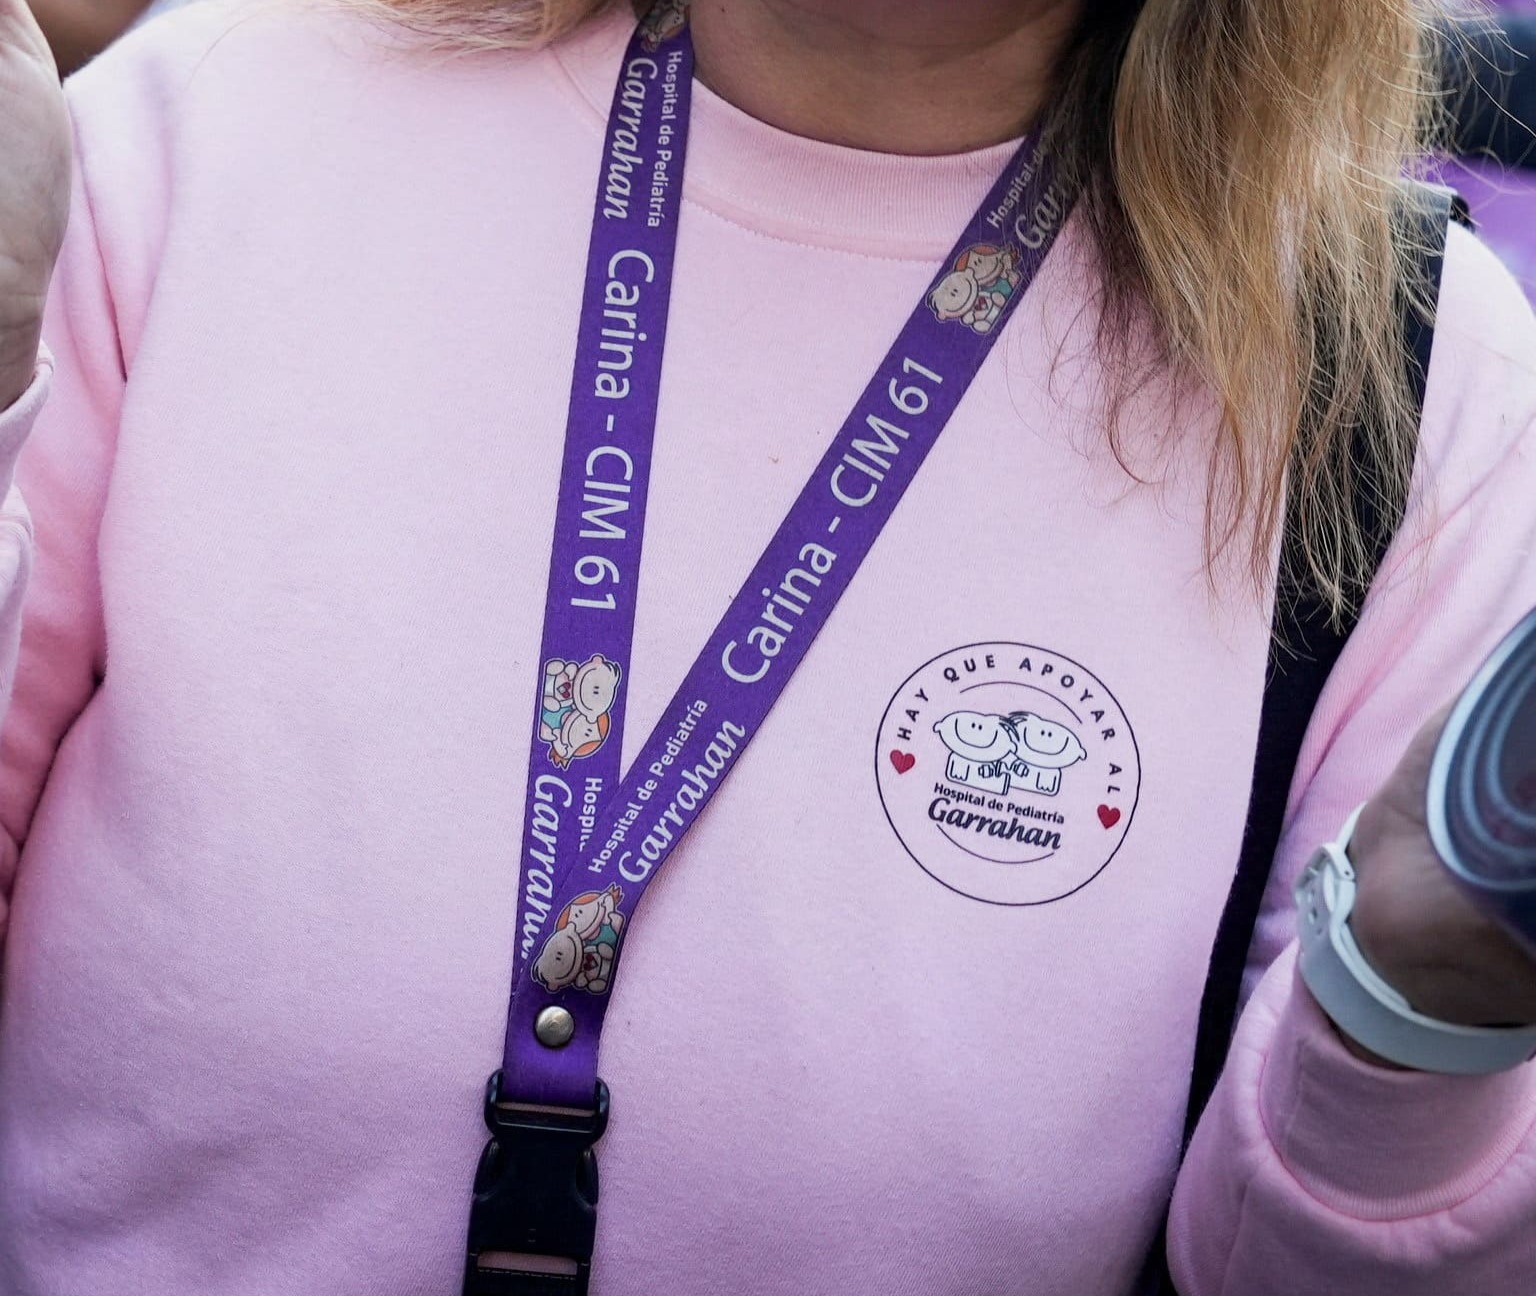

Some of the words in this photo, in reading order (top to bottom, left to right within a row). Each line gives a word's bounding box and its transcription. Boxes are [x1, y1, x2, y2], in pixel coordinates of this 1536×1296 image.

[661, 51, 682, 121] Hospital
[603, 57, 658, 220] Garrahan
[658, 124, 674, 145] de
[648, 149, 672, 227] Pediatría
[986, 162, 1034, 229] Hospital
[594, 249, 655, 399] Carina
[579, 445, 634, 539] CIM
[722, 542, 837, 684] Carina
[830, 413, 910, 508] CIM
[888, 357, 944, 416] 61
[570, 555, 620, 610] 61
[897, 688, 929, 740] HAY
[943, 654, 995, 683] QUE
[1019, 657, 1116, 740] APOYAR
[1107, 762, 1122, 794] AL
[588, 802, 643, 873] Hospital
[637, 779, 658, 801] de
[649, 699, 708, 777] Pediatría
[618, 720, 746, 883] Garrahan
[927, 797, 1062, 850] Garrahan
[933, 782, 986, 808] Hospital
[987, 798, 1005, 811] de
[1006, 802, 1065, 824] Pediatría
